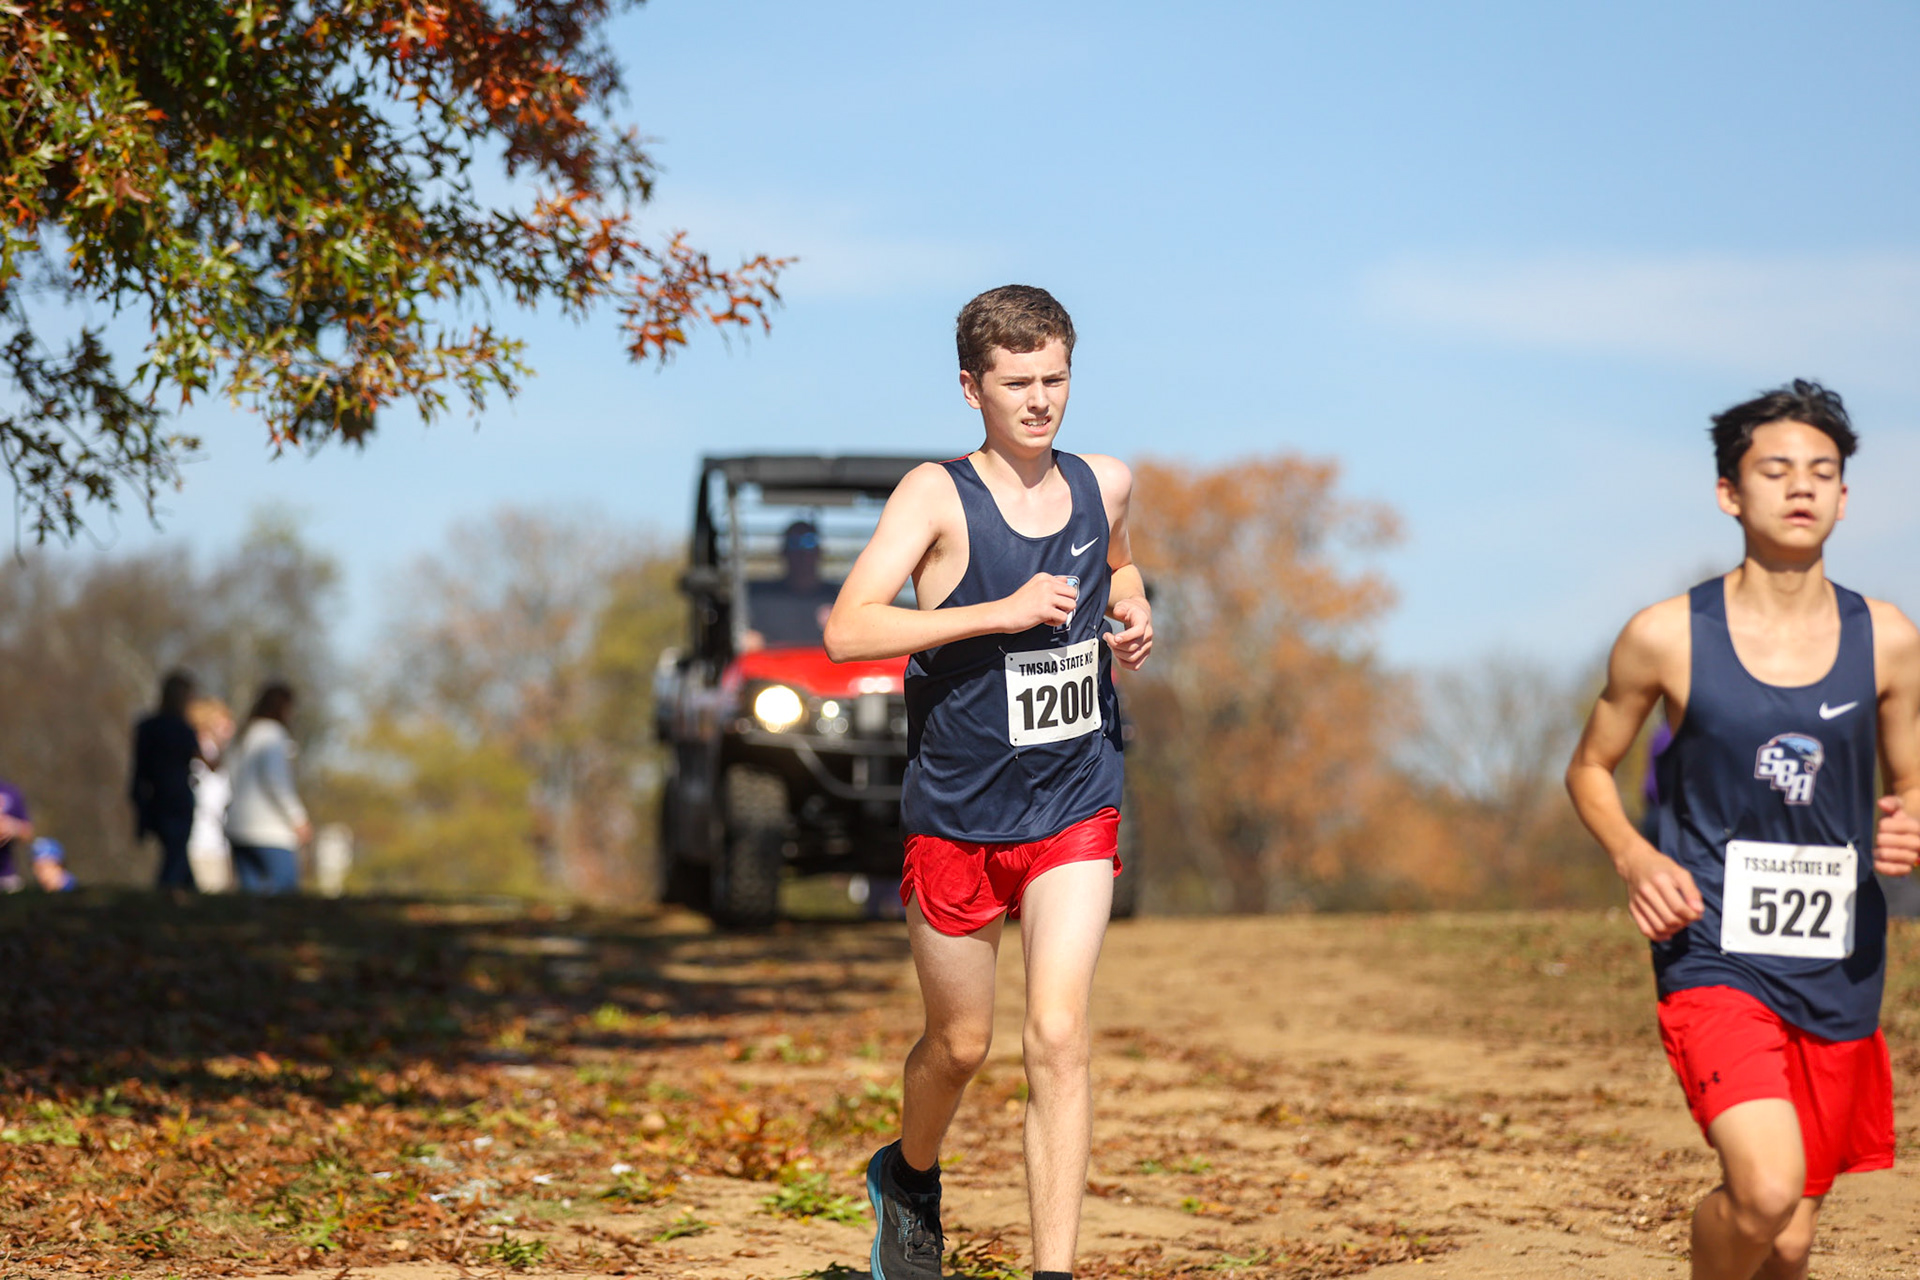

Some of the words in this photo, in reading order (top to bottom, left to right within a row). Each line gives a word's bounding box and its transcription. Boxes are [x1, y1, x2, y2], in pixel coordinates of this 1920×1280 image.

[1019, 660, 1058, 676] TMSAA
[1060, 655, 1084, 672] STATE
[1085, 651, 1093, 665] XC
[1015, 675, 1094, 731] 1200
[1790, 859, 1822, 875] STATE
[1749, 886, 1833, 939] 522
